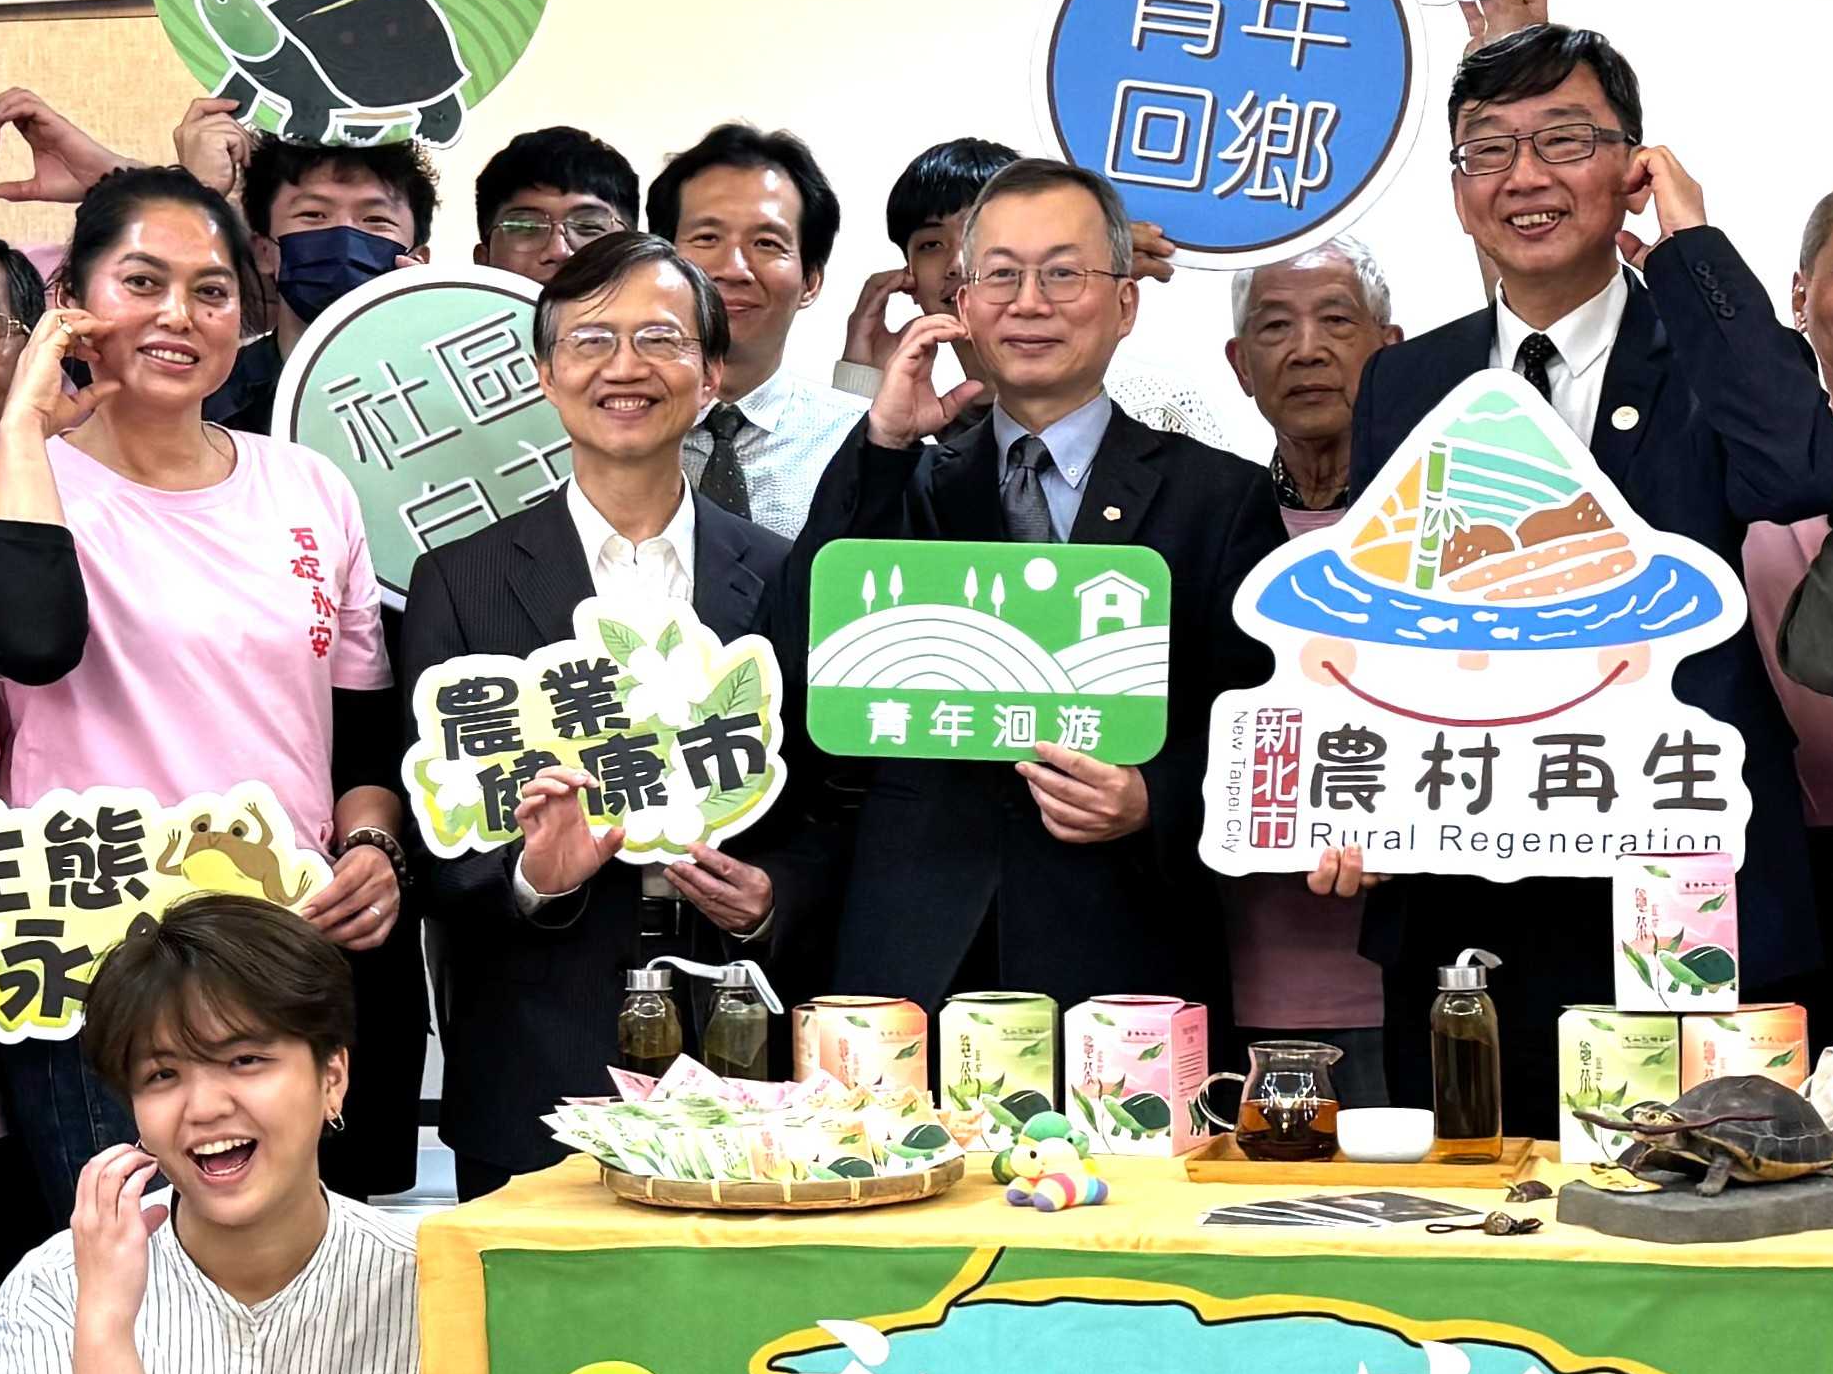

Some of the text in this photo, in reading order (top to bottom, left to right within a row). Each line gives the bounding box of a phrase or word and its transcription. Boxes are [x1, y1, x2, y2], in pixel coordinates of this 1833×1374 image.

[1105, 79, 1339, 209] 回鄉
[289, 527, 339, 658] 石碇永安
[436, 658, 630, 760] 農業
[866, 699, 1102, 751] 青年洄游
[1231, 710, 1249, 752] New
[1250, 708, 1303, 848] 新北市
[1309, 723, 1728, 815] 農村再生
[1221, 819, 1242, 854] City
[1310, 823, 1723, 859] Rural Regeneration
